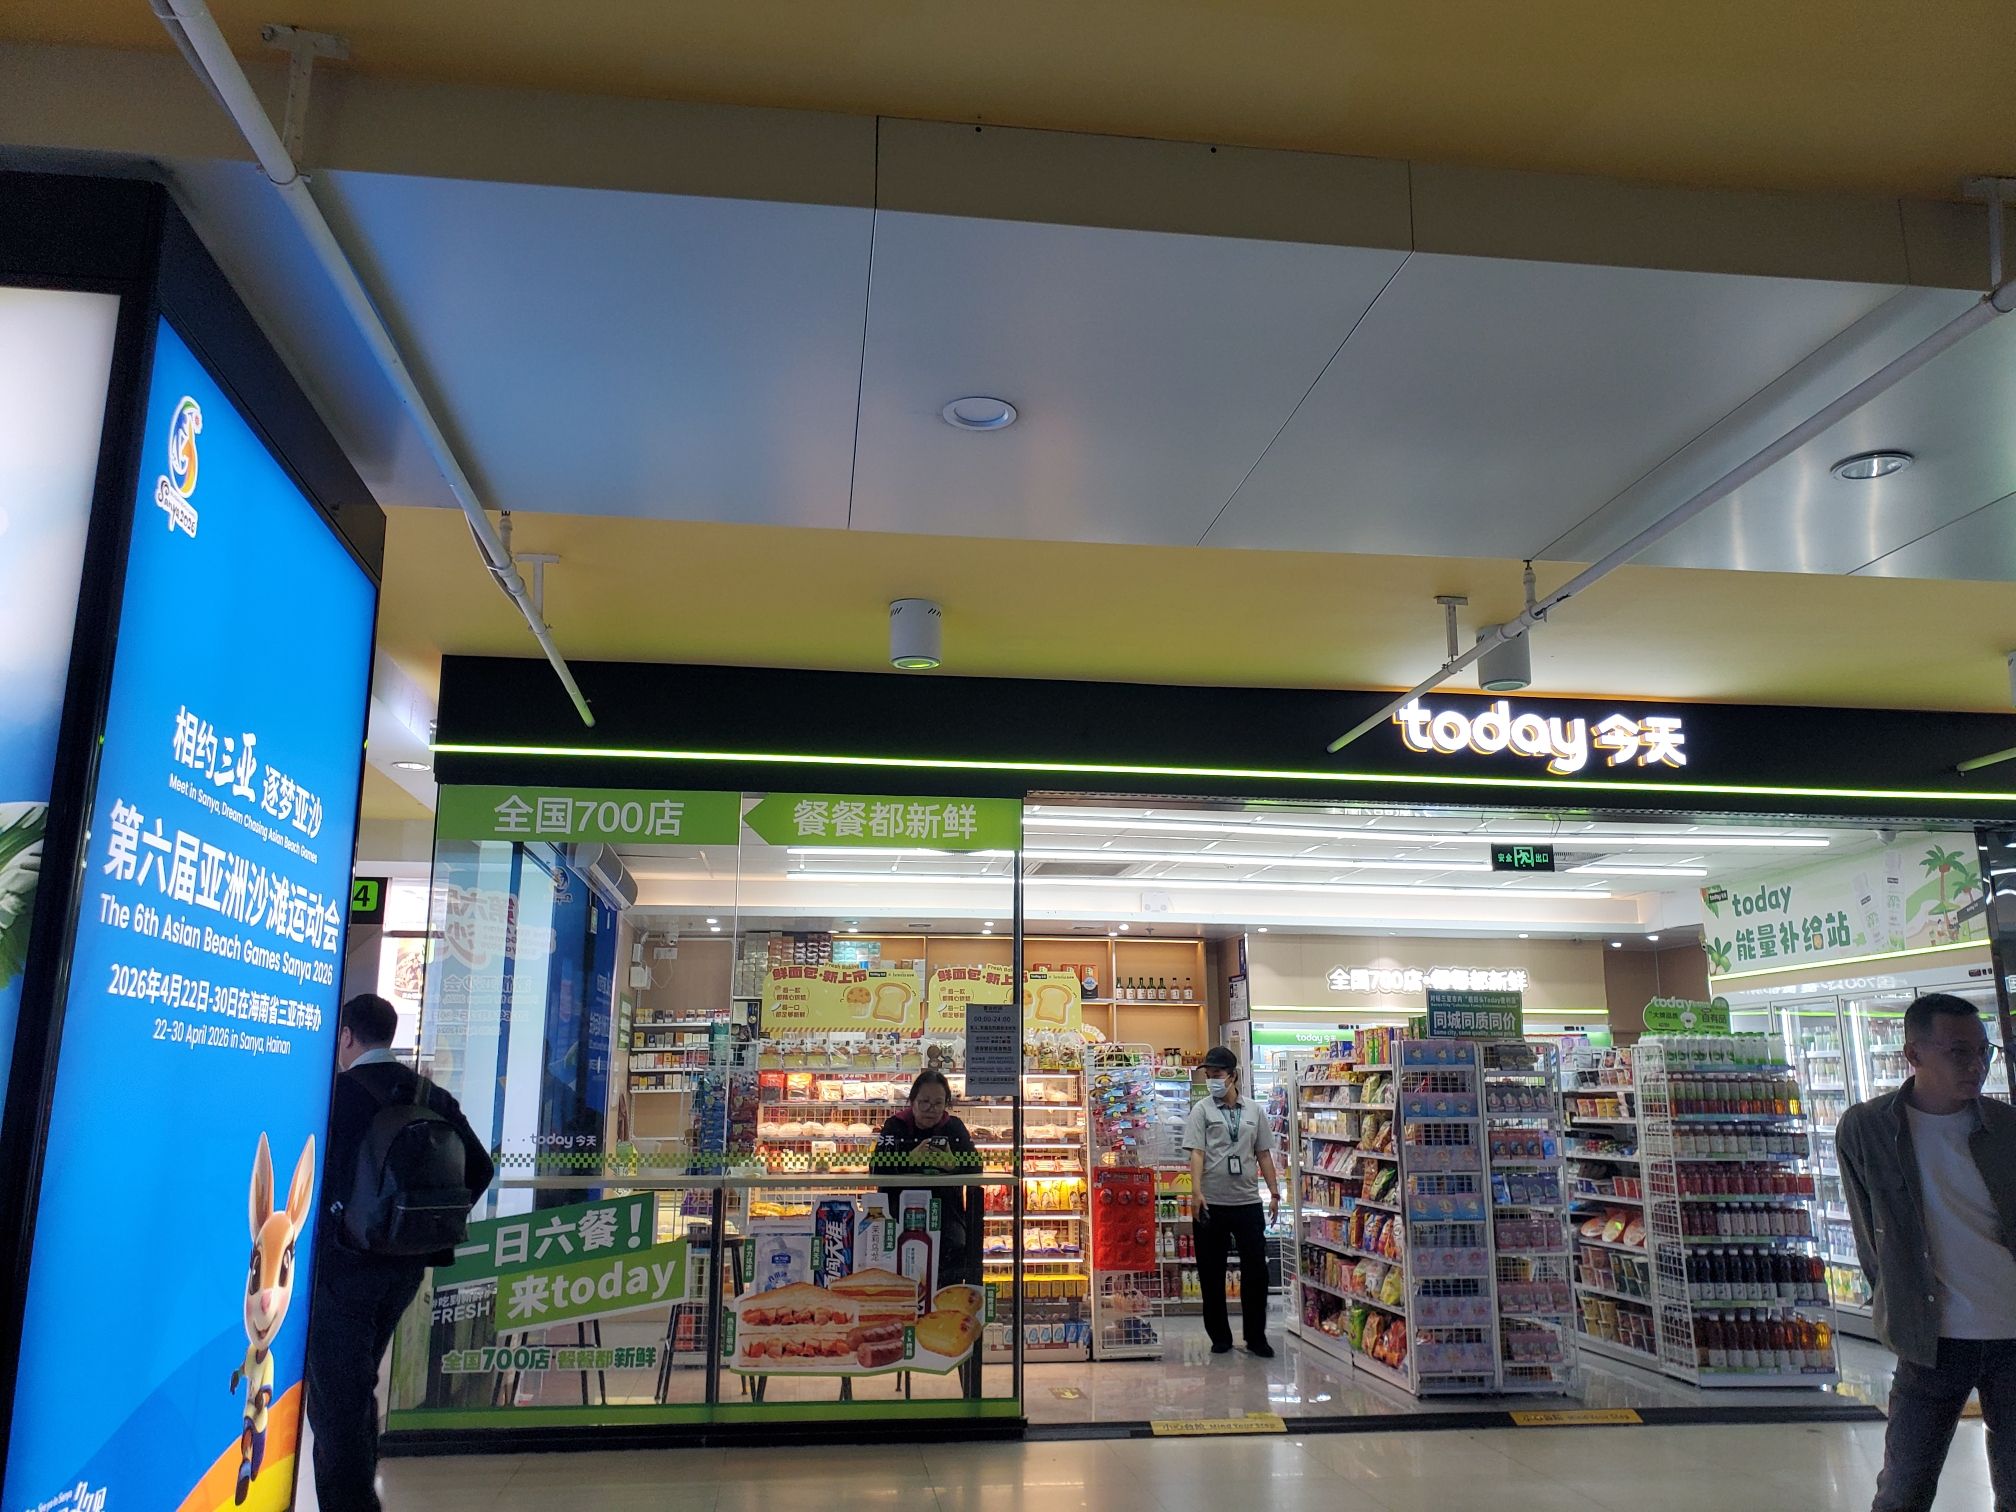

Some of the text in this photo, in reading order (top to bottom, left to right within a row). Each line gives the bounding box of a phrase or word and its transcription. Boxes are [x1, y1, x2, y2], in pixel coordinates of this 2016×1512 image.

[1393, 698, 1687, 775] today 今天
[173, 705, 323, 839] 相约三亚 逐梦亚沙
[169, 773, 318, 865] Meet in Sanya, Dream Chasing Asian Beach Games
[494, 794, 685, 837] 全国700店
[793, 799, 978, 841] 餐餐都新鲜
[103, 797, 341, 954] 第六届亚洲沙滩运动会
[1498, 853, 1549, 863] 安全 出口
[354, 884, 370, 907] 4
[1732, 885, 1791, 917] today
[100, 892, 333, 986] The 6th Asian Beach Games Sanya 2026
[1736, 911, 1850, 961] 能量补给站
[107, 963, 322, 1032] 2026年4月22日-30日在海南省三亚市举办
[152, 1018, 291, 1056] 22-30 April 2026 in Sanya, Hainan
[1296, 1033, 1323, 1044] today
[1433, 1011, 1516, 1030] 同城同质同价
[530, 1133, 597, 1149] today 今天
[507, 1261, 677, 1320] 来today
[431, 1301, 490, 1326] FRESH
